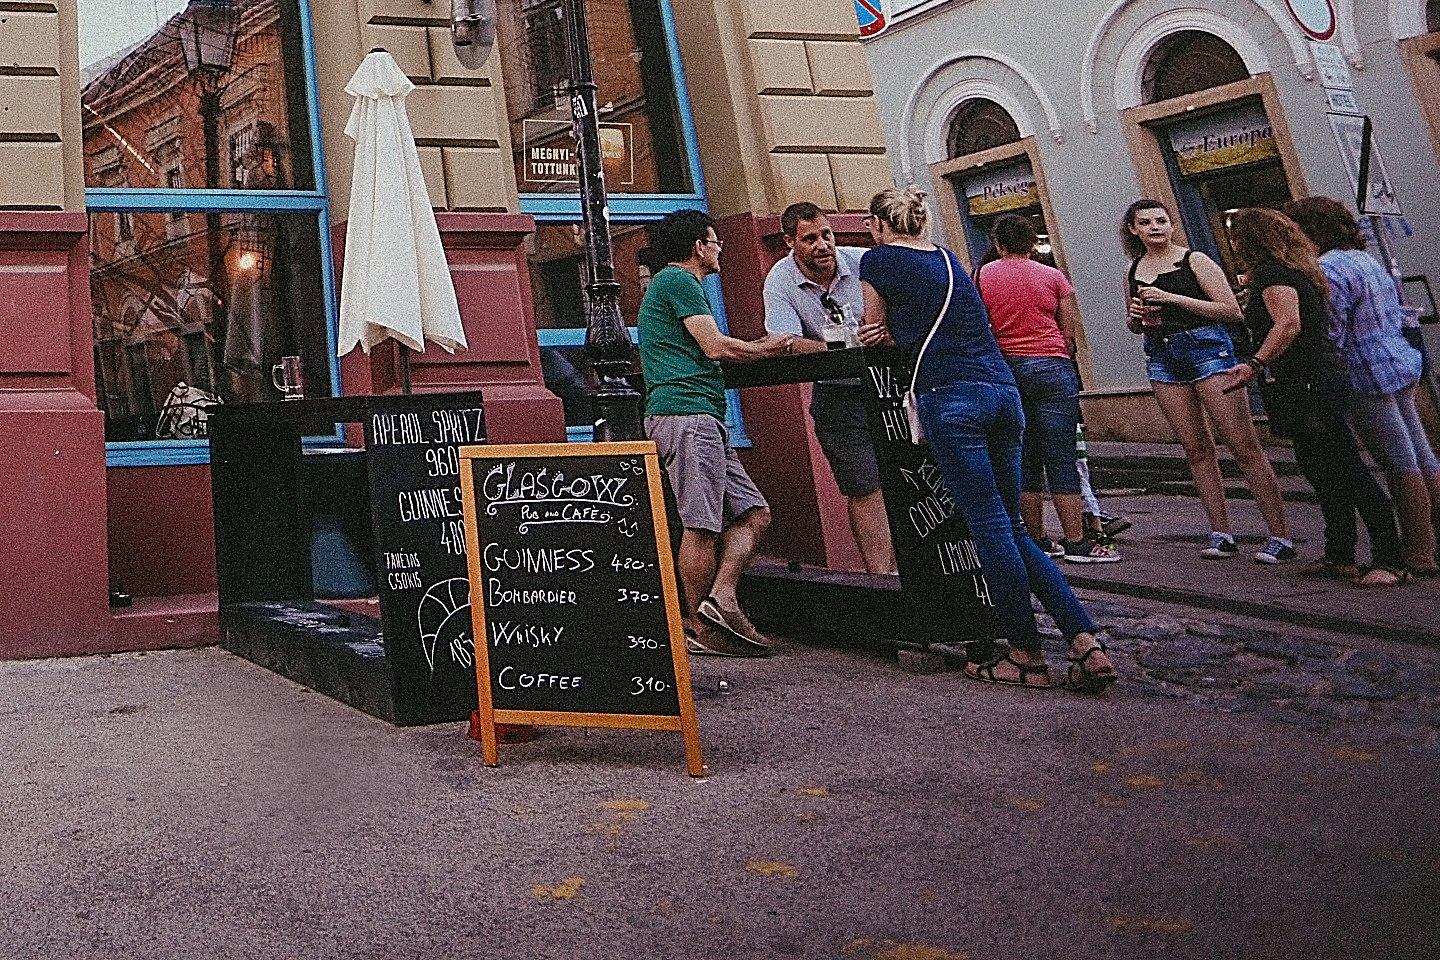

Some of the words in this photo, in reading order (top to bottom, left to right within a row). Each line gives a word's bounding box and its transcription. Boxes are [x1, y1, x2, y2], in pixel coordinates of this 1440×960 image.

[531, 147, 574, 161] MEGNYI-
[531, 162, 576, 176] TOTTUNK
[372, 413, 429, 445] APEROL
[431, 408, 485, 444] SPRITZ
[425, 445, 459, 477] 960
[482, 461, 628, 502] GLASGOW
[483, 542, 596, 573] GUINNESS
[388, 571, 422, 590] CSOKIS
[488, 577, 578, 607] BOMBARDIER
[498, 665, 582, 691] COFFEE
